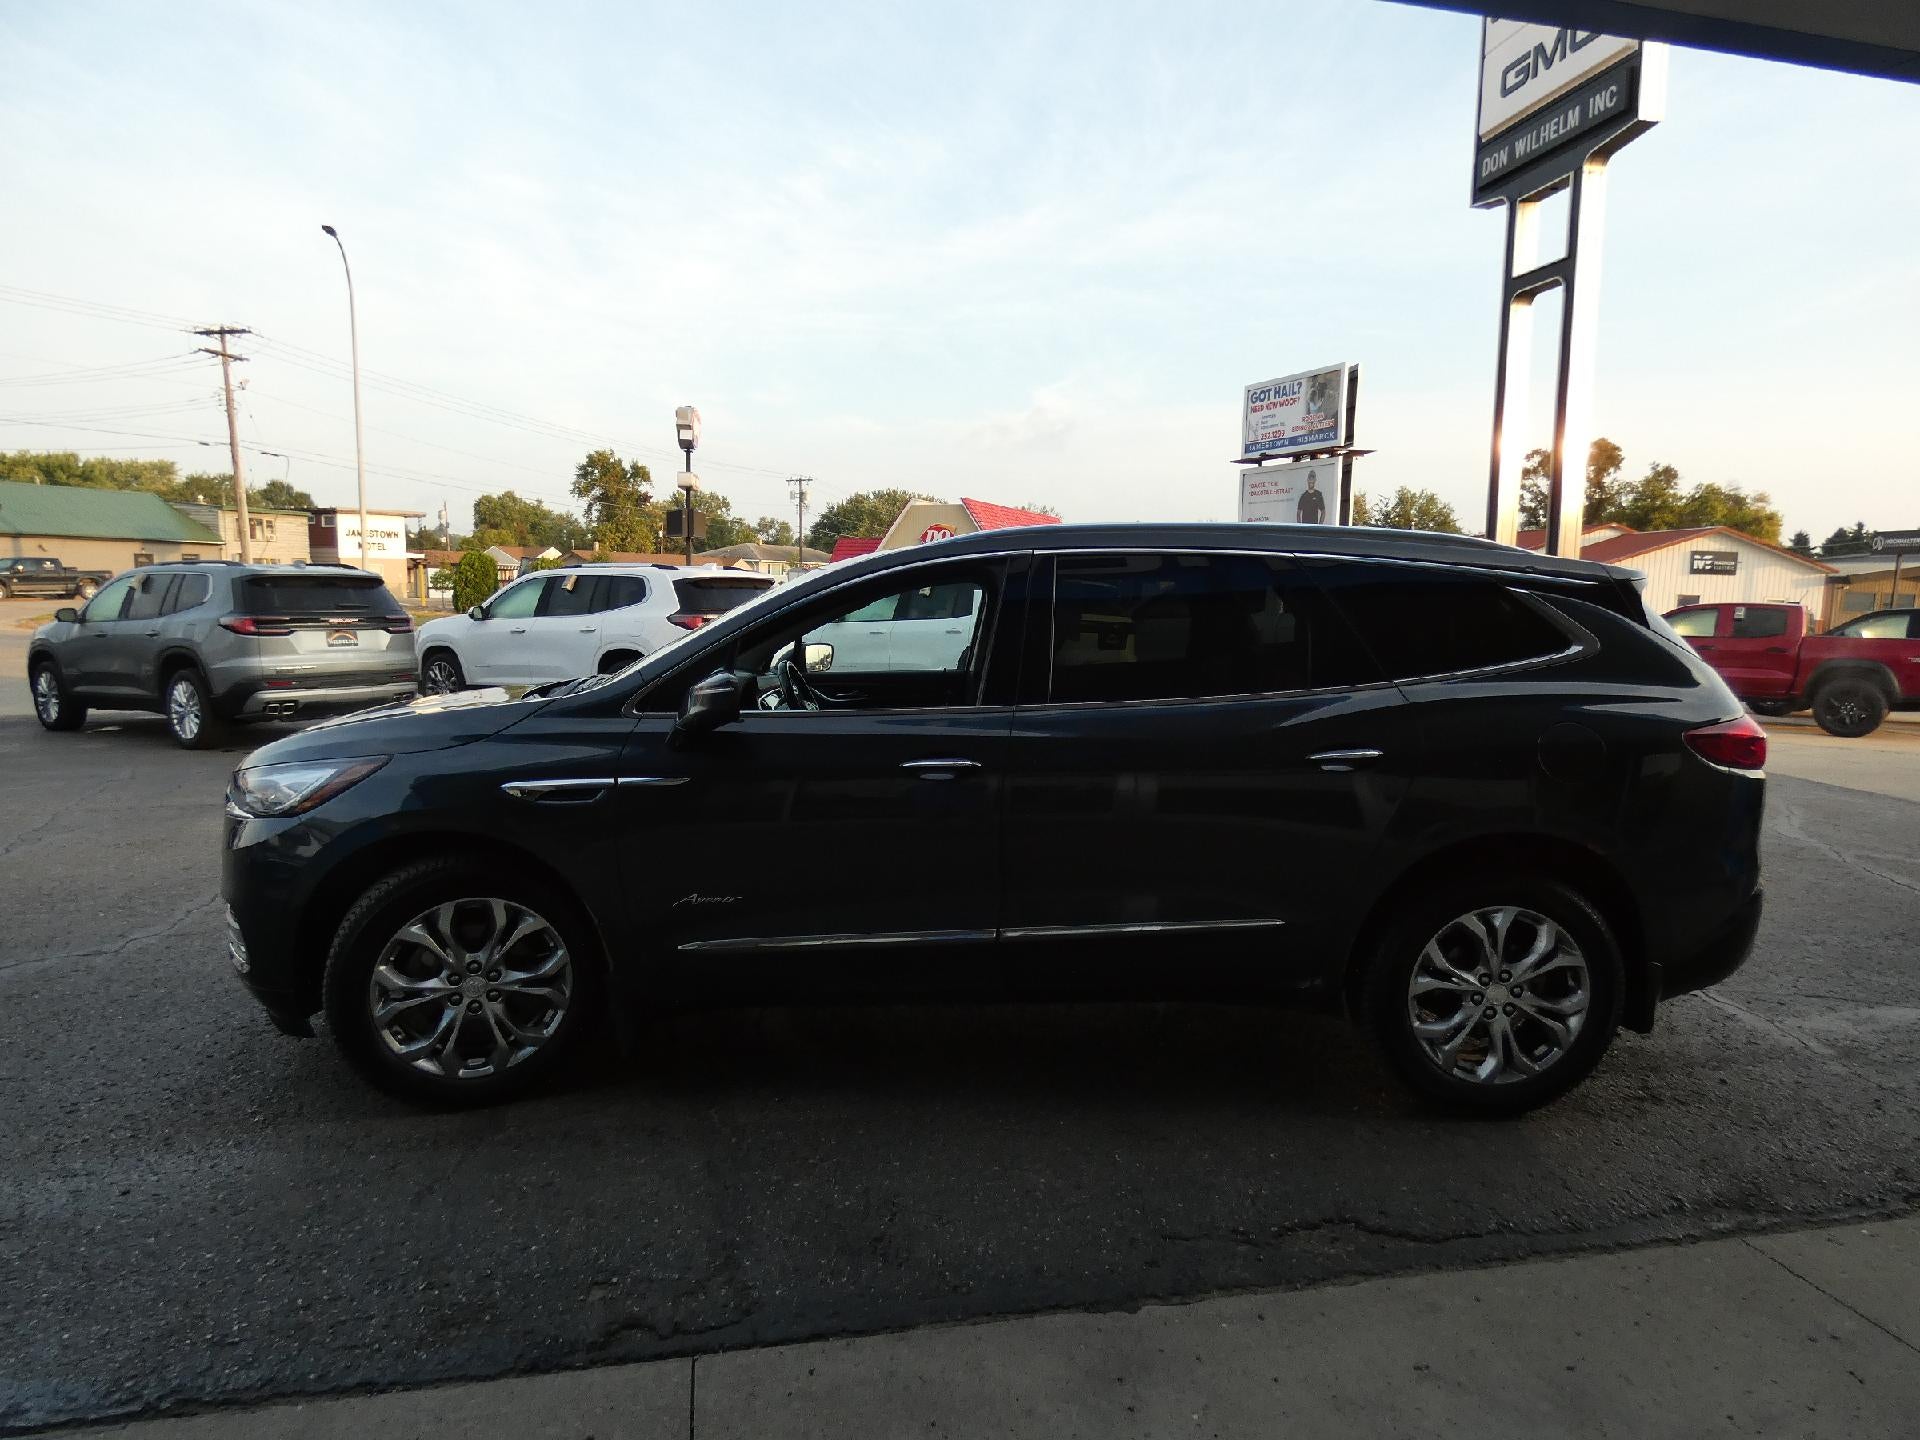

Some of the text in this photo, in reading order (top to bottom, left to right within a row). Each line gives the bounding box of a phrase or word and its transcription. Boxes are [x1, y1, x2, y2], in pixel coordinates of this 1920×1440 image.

[1482, 85, 1617, 177] DON WILHELM INC
[1250, 381, 1303, 404] GOT HAIL?
[345, 529, 399, 539] JAMSTOWN
